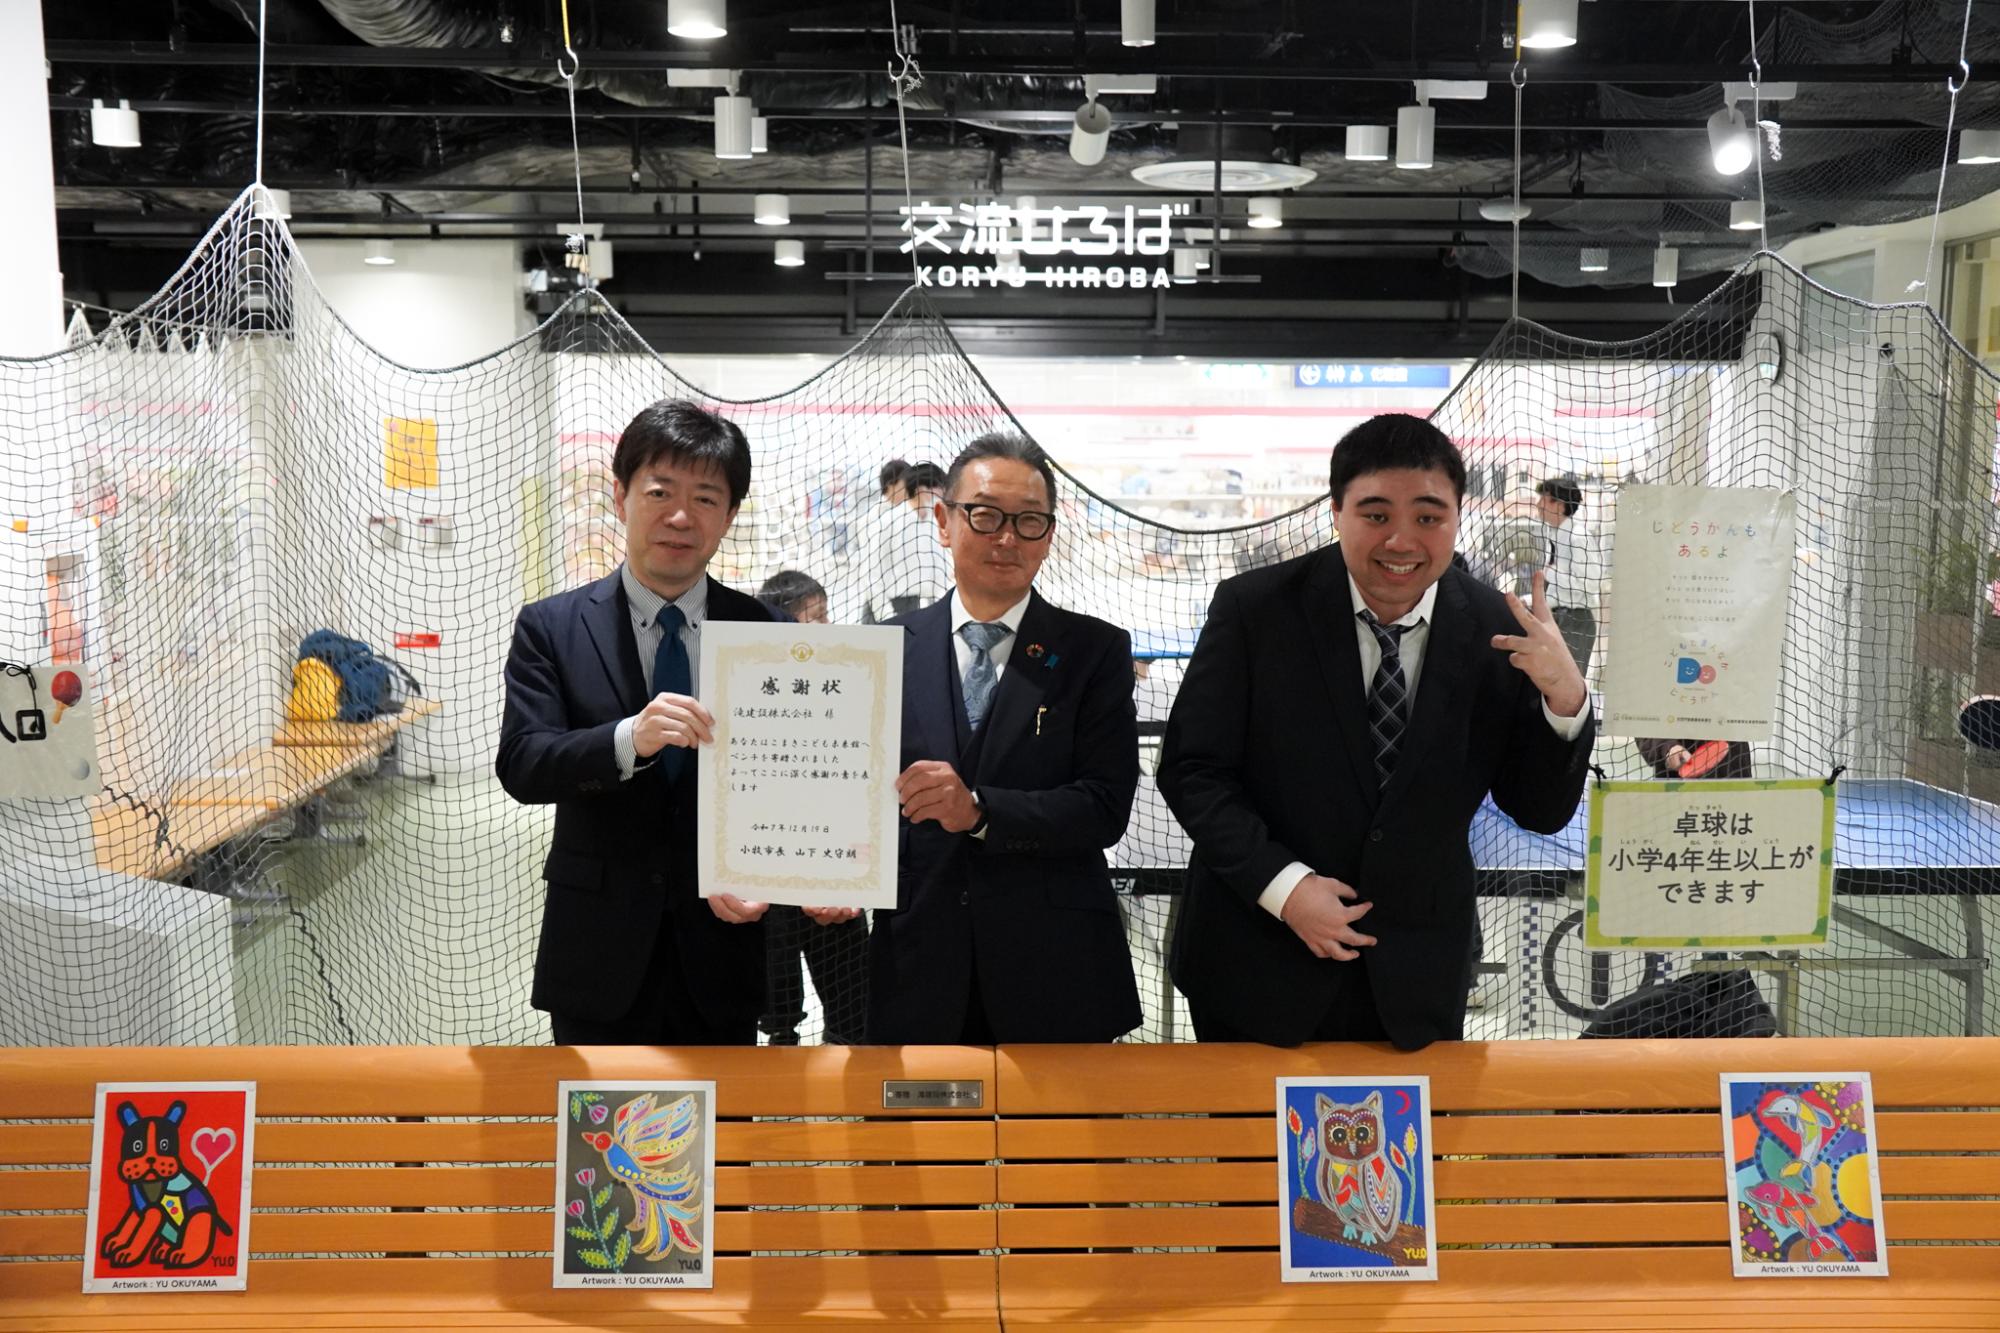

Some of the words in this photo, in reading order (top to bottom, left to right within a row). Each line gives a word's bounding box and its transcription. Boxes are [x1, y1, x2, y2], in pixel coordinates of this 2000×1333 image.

[900, 202, 1190, 255] 交流ひろば
[917, 266, 1026, 288] KORYU
[1045, 266, 1171, 288] HIROBA
[1652, 520, 1757, 538] じどうかんも
[1678, 543, 1729, 559] あるよ
[760, 676, 842, 695] 感謝状
[730, 783, 758, 793] します
[1673, 811, 1753, 838] 卓球は
[740, 845, 786, 857] 小牧市長
[794, 847, 817, 858] 山下
[1608, 845, 1815, 873] 小学4年生以上が
[1657, 879, 1765, 904] できます
[1309, 1270, 1344, 1279] Artwork
[1351, 1270, 1363, 1278] YU
[1365, 1269, 1410, 1278] OKUYAMA
[1761, 1265, 1795, 1274] Artwork
[1802, 1265, 1813, 1273] YU
[1816, 1264, 1861, 1273] OKUYAMA
[112, 1280, 148, 1290] Artwork
[156, 1279, 168, 1289] YU
[171, 1279, 218, 1288] OKUYAMA
[581, 1276, 616, 1285] Artwork
[624, 1276, 636, 1285] YU
[638, 1276, 685, 1285] OKUYAMA
